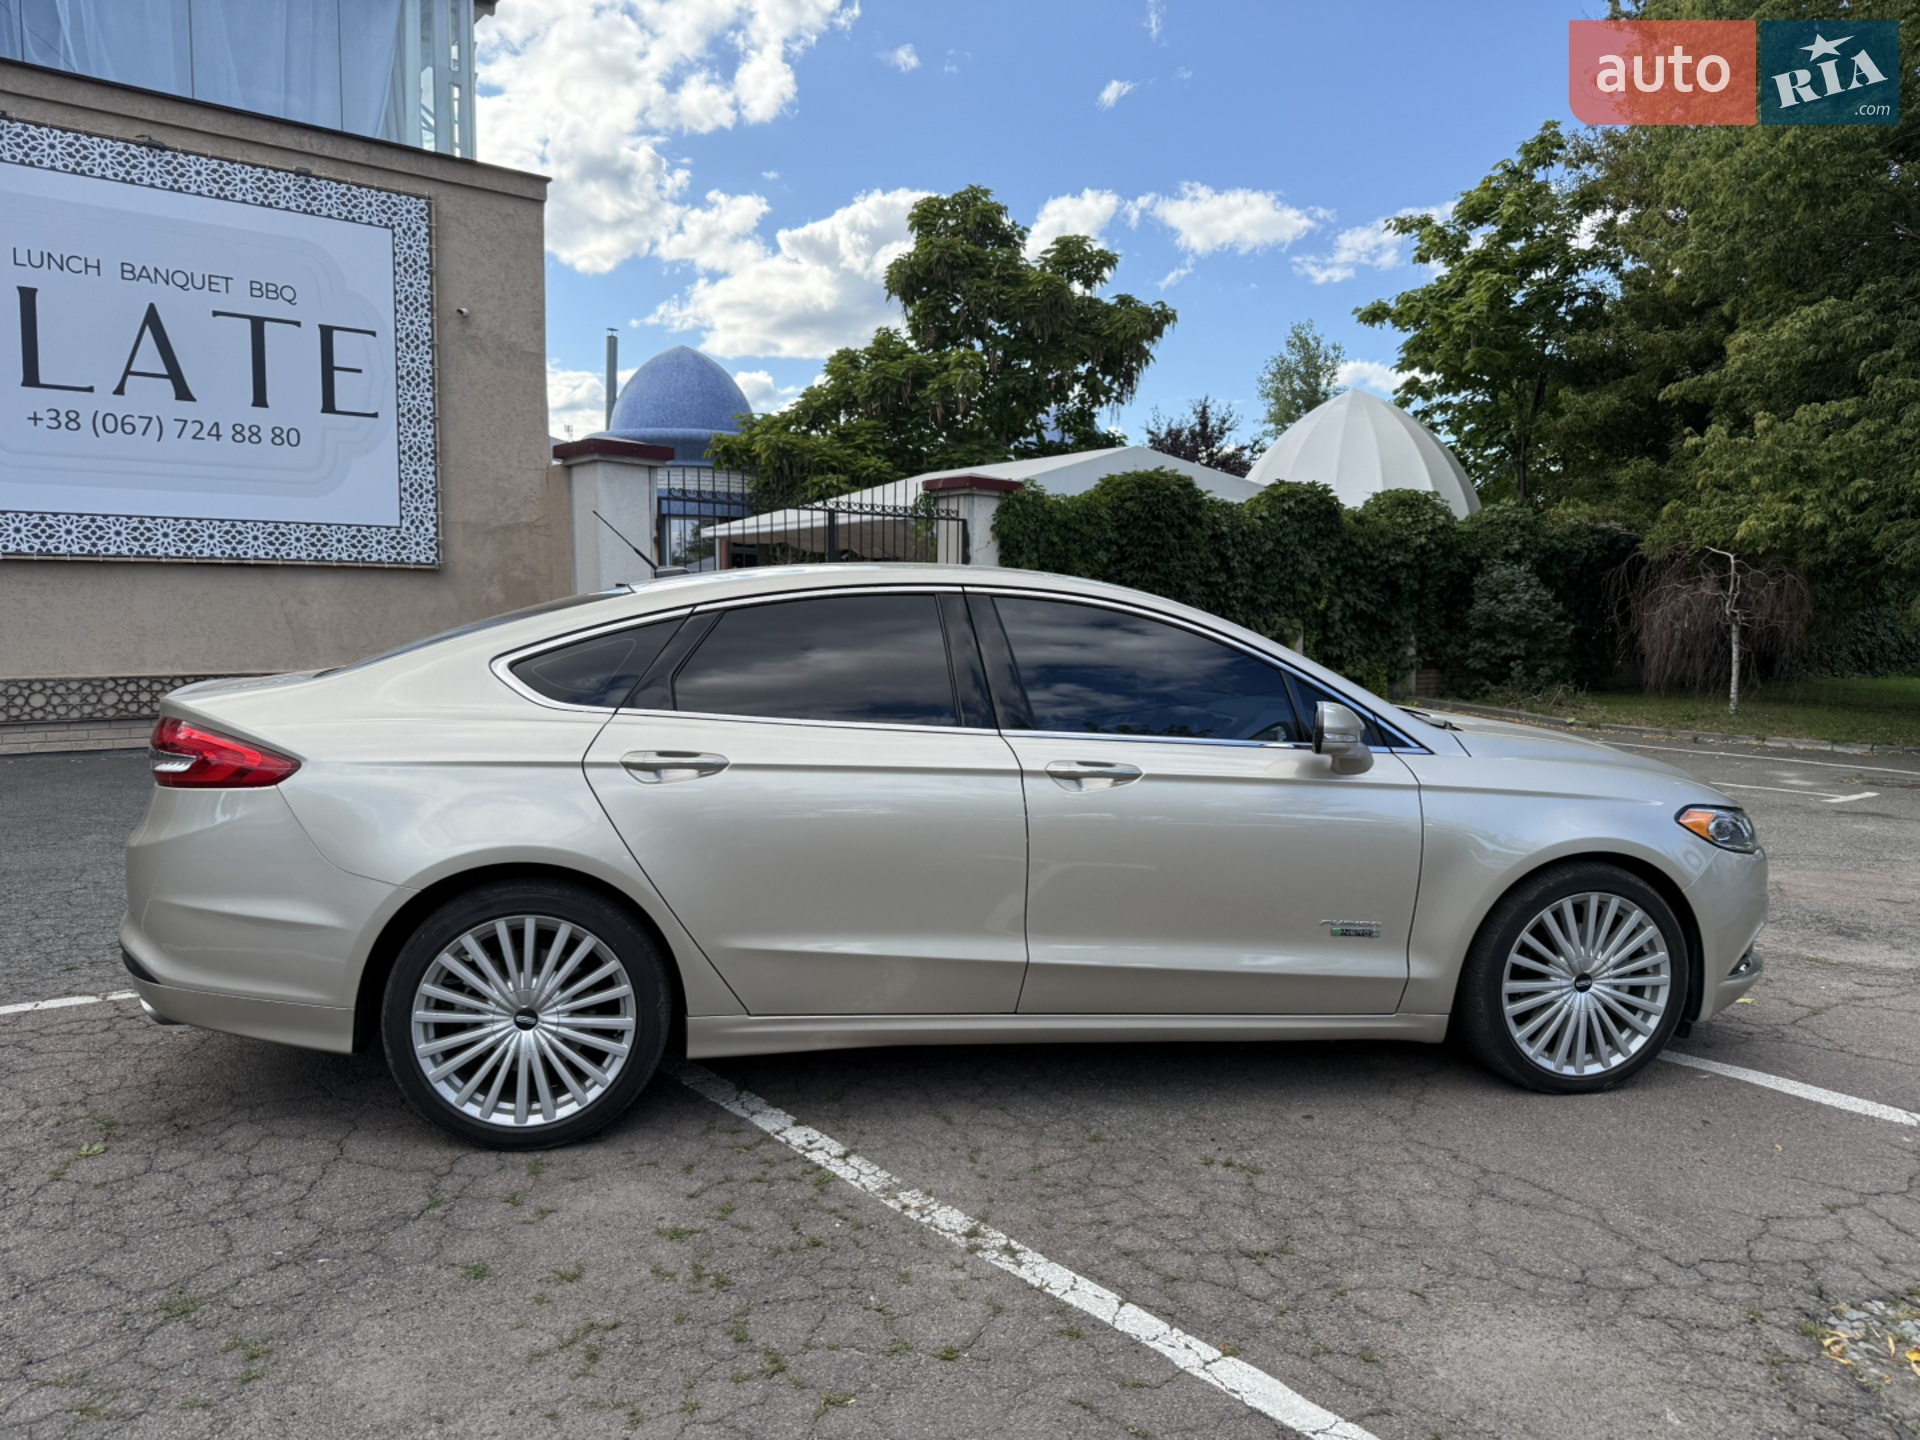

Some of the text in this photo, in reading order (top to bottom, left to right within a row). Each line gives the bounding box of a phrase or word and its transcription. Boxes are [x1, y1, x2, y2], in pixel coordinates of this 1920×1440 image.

[12, 246, 298, 306] LUNCH BANQUET BBQ
[16, 285, 380, 420] LATE
[26, 407, 301, 448] +38 (067) 724 88 80
